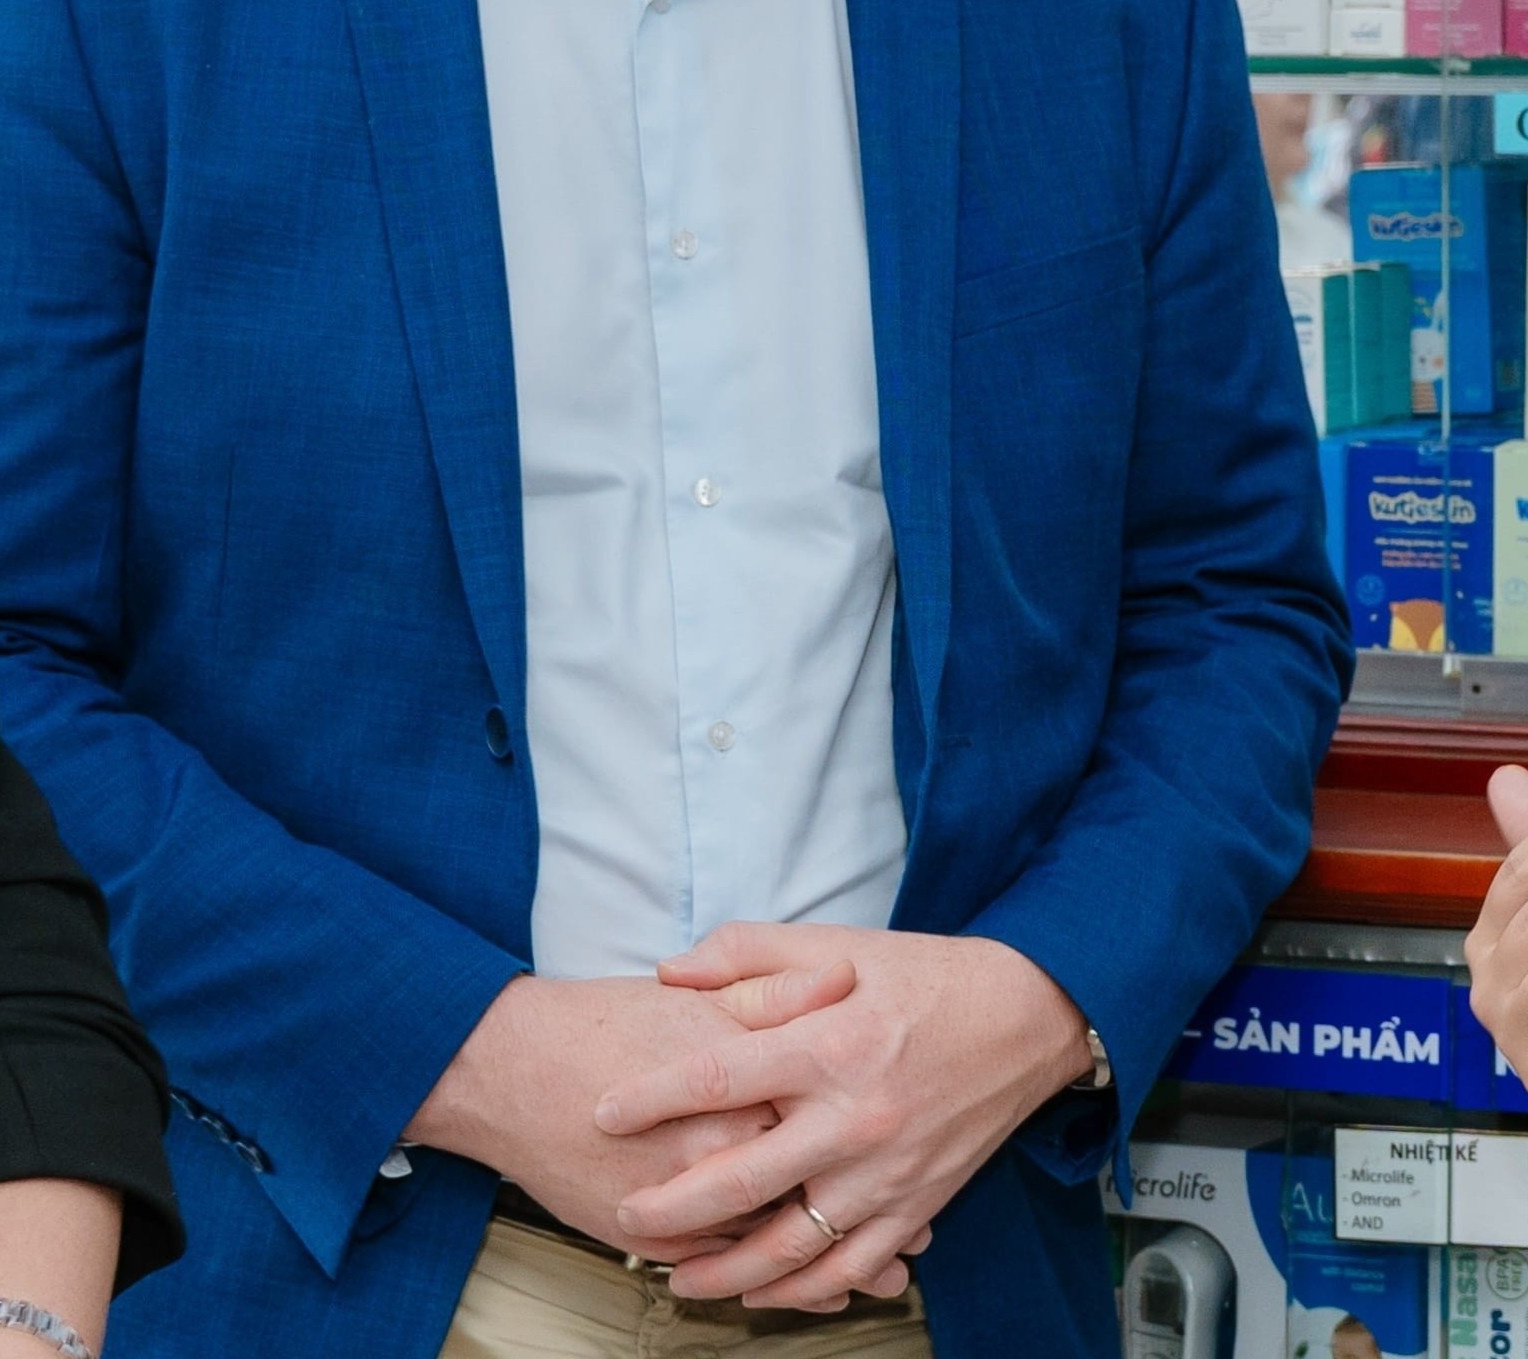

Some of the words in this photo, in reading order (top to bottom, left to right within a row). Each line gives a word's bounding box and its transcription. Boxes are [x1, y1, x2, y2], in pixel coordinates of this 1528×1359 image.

[1213, 1007, 1300, 1056] SẢN
[1313, 1016, 1440, 1066] PHẨM
[1455, 1138, 1479, 1162] KẾ
[1352, 1215, 1384, 1231] AND
[1449, 1251, 1478, 1347] Nasa
